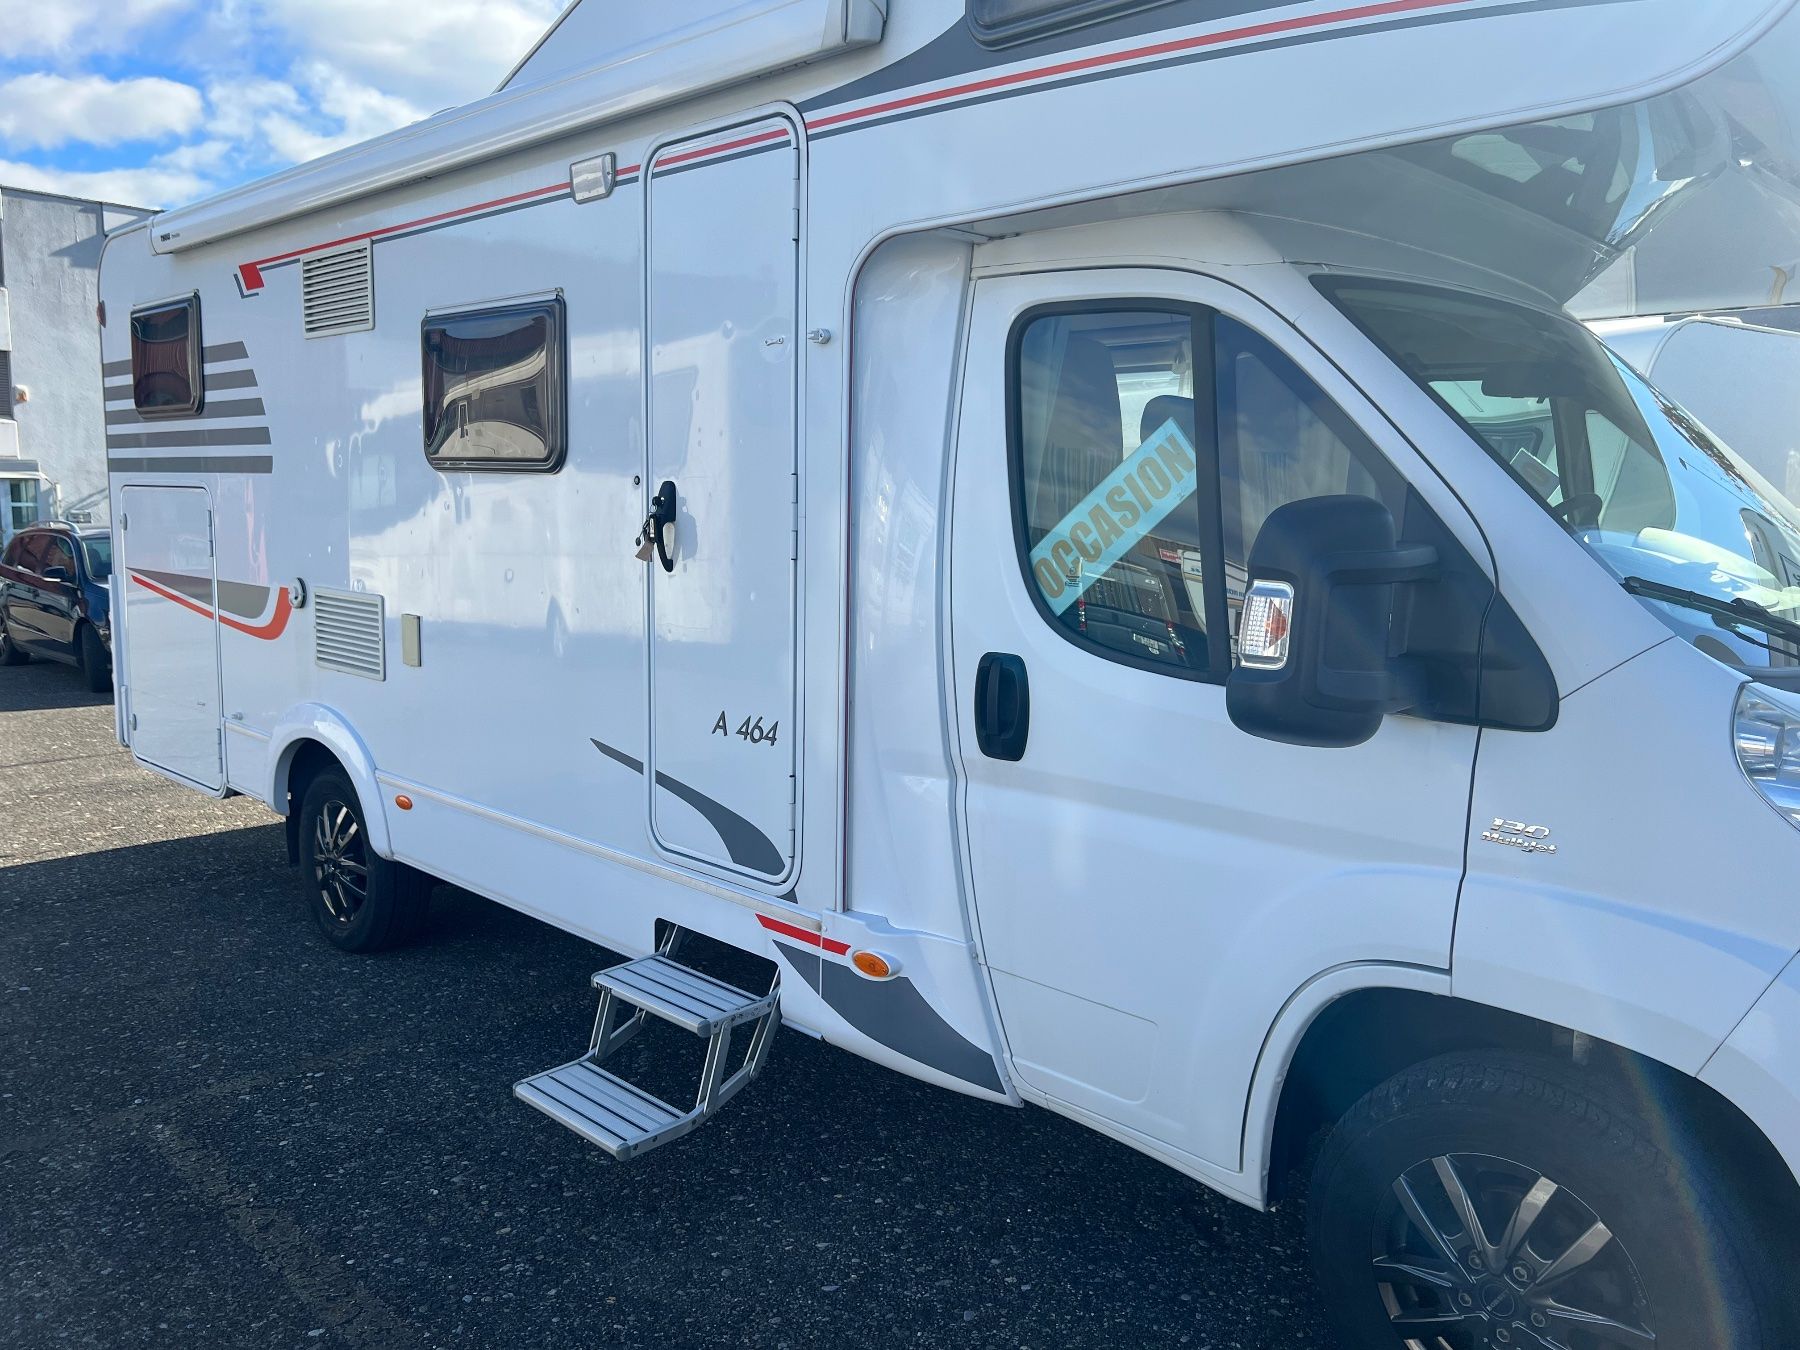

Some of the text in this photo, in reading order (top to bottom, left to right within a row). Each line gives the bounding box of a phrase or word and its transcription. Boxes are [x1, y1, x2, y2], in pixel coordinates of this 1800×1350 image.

[1033, 432, 1196, 600] OCCASION
[711, 710, 780, 747] A 464
[1489, 817, 1551, 840] 130
